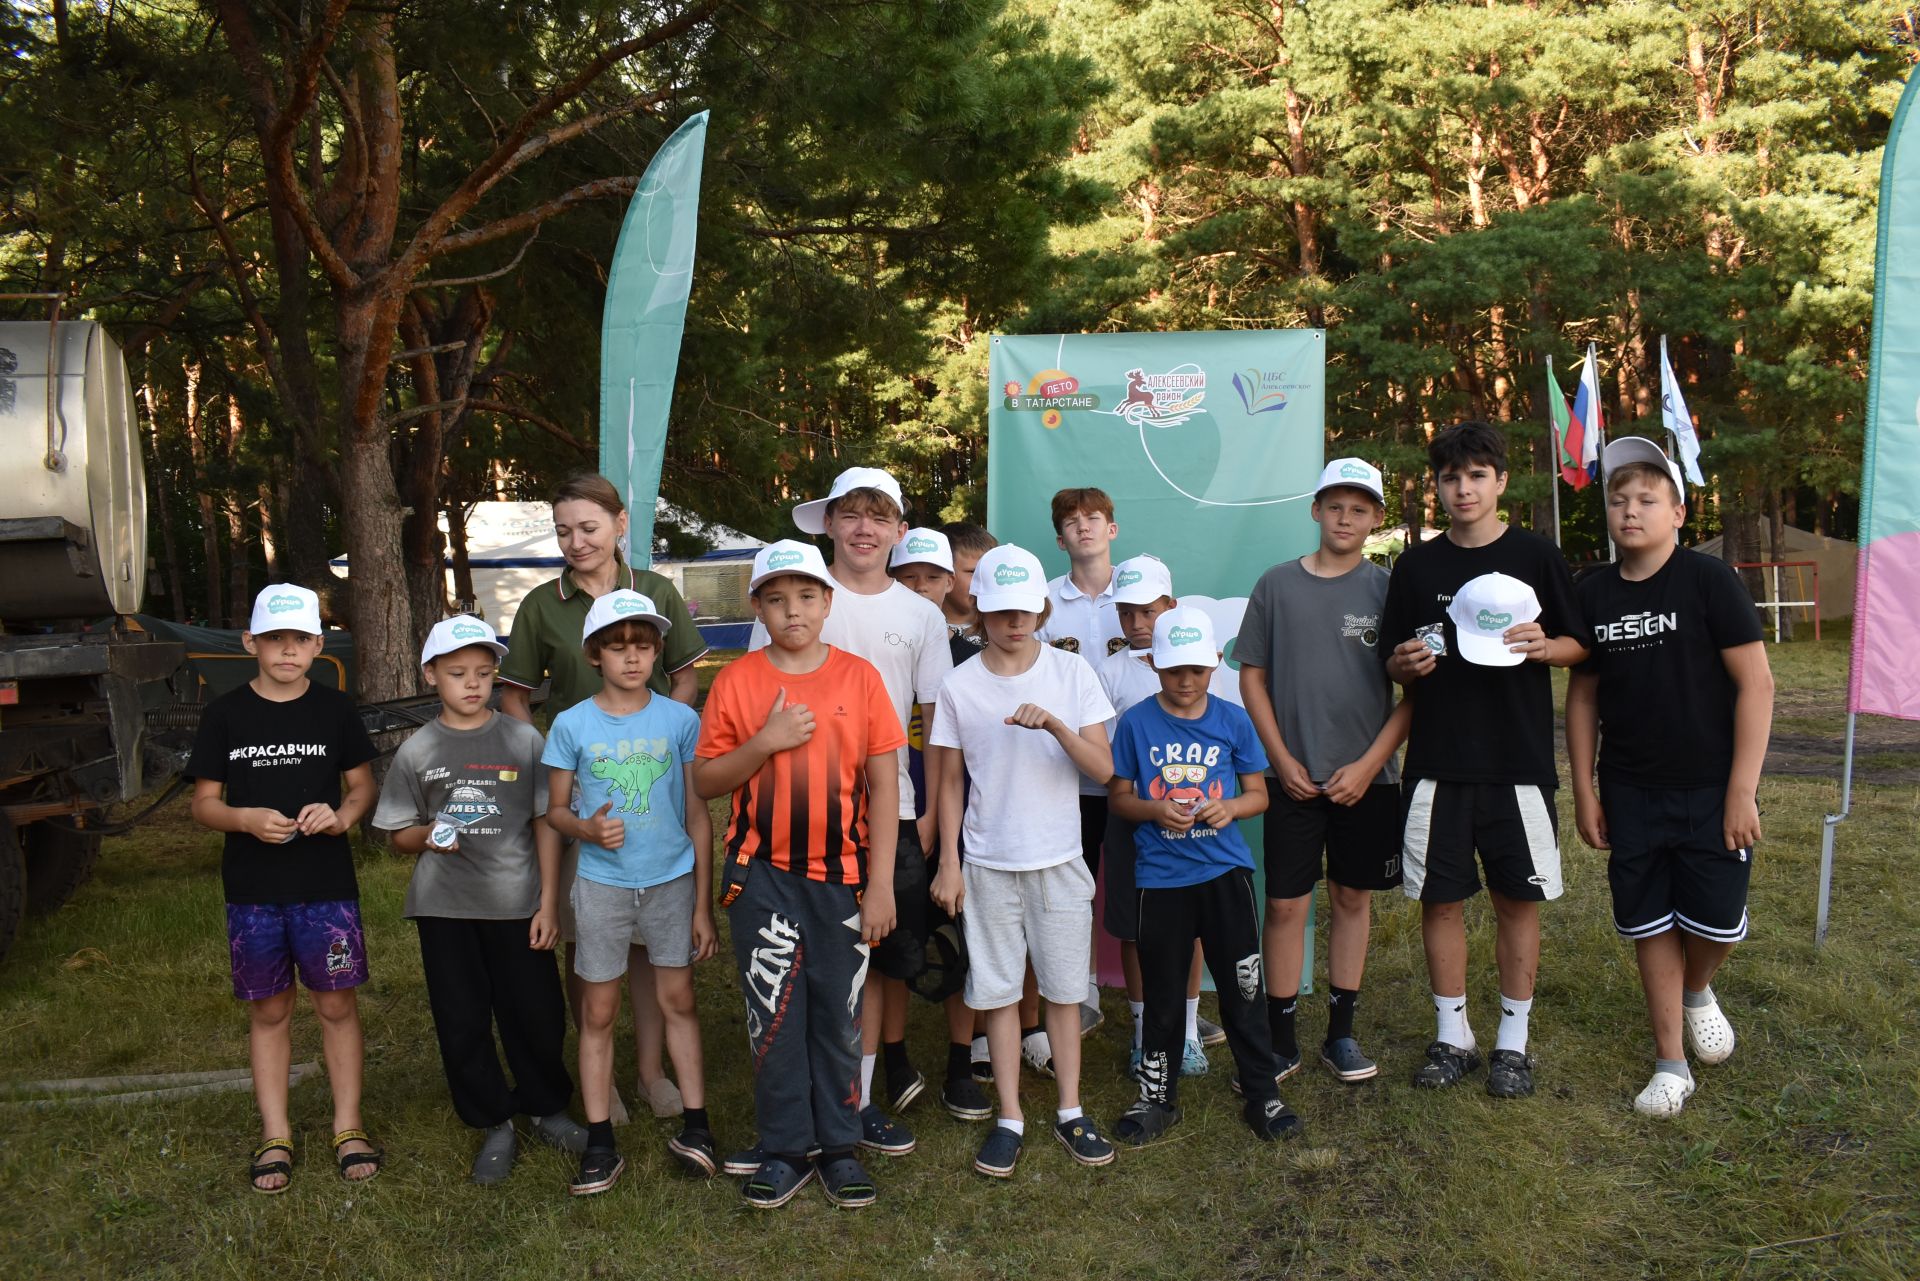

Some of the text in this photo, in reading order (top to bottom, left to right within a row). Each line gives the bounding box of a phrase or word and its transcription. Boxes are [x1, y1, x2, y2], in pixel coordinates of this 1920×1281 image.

[1148, 373, 1204, 387] АЛЕКСЕЕВСКИЙ
[1047, 381, 1073, 395] ЛЕТО
[1026, 397, 1092, 408] ТАТАРСТАНЕ
[1156, 390, 1182, 401] район
[1595, 612, 1677, 643] DESIGN
[229, 744, 327, 761] #КРАСАВЧИК
[1149, 742, 1220, 766] CRAB
[252, 759, 272, 767] ВЕСЬ
[280, 757, 302, 765] ПАПУ
